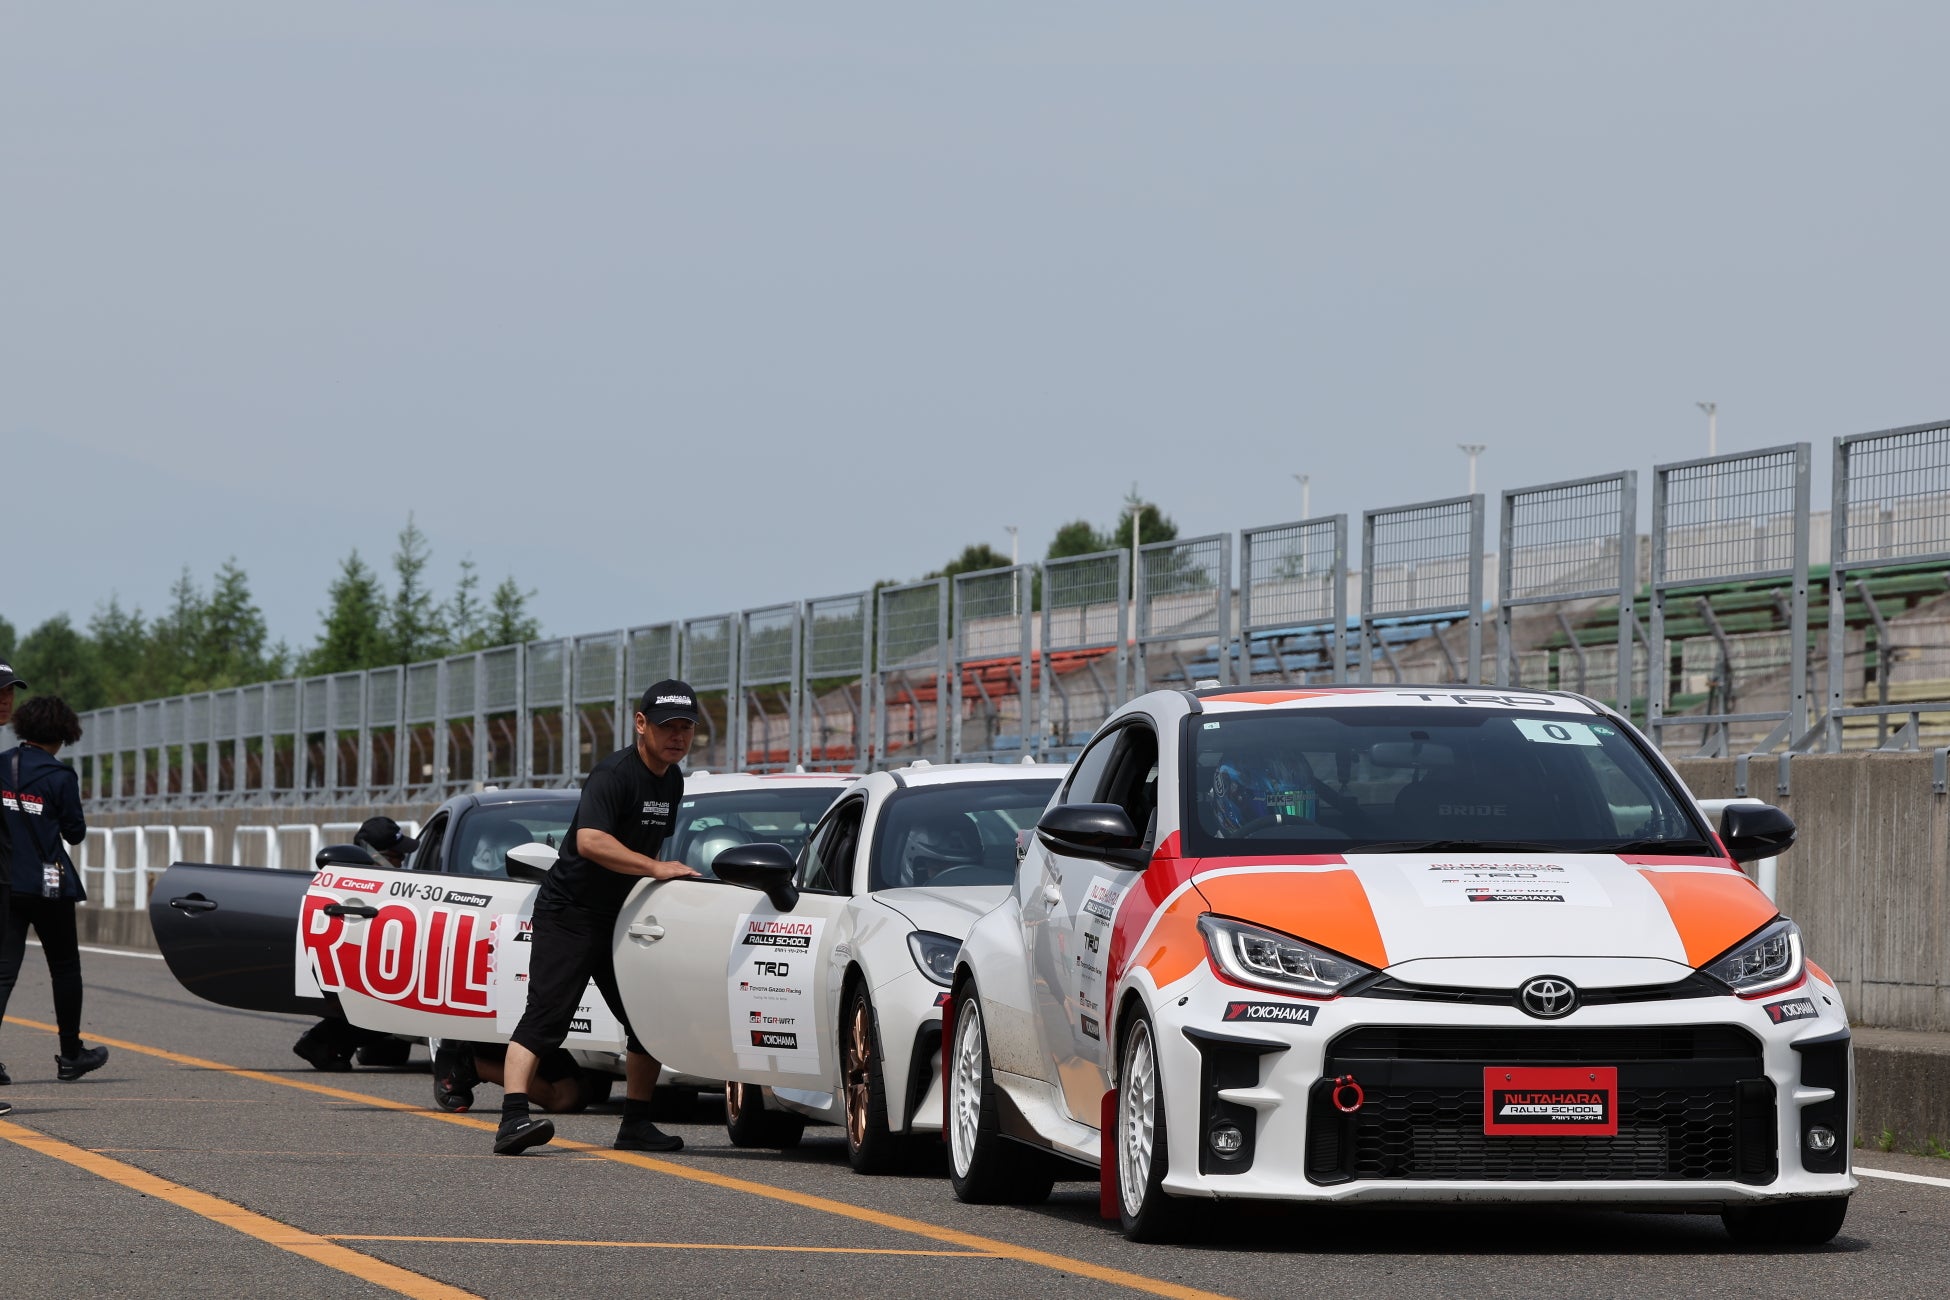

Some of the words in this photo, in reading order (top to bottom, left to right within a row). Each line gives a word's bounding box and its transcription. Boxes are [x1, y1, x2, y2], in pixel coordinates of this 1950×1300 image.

[1397, 693, 1555, 707] TRD
[1542, 723, 1572, 741] 0
[1438, 804, 1508, 816] BRIDE
[341, 879, 375, 890] Circuit
[389, 881, 443, 902] 0W-30
[450, 892, 486, 906] Touring
[749, 921, 812, 935] NUTAHARA
[749, 936, 775, 945] RALLY
[776, 937, 807, 946] SCHOOL
[754, 961, 790, 977] TRD
[1246, 1005, 1310, 1021] YOKOHAMA
[763, 1017, 795, 1025] TGR-WRT
[763, 1034, 796, 1046] YOKOHAMA
[1504, 1093, 1603, 1104] NUTAHARA
[1510, 1106, 1548, 1114] RALLY
[1552, 1106, 1598, 1114] SCHOOL
